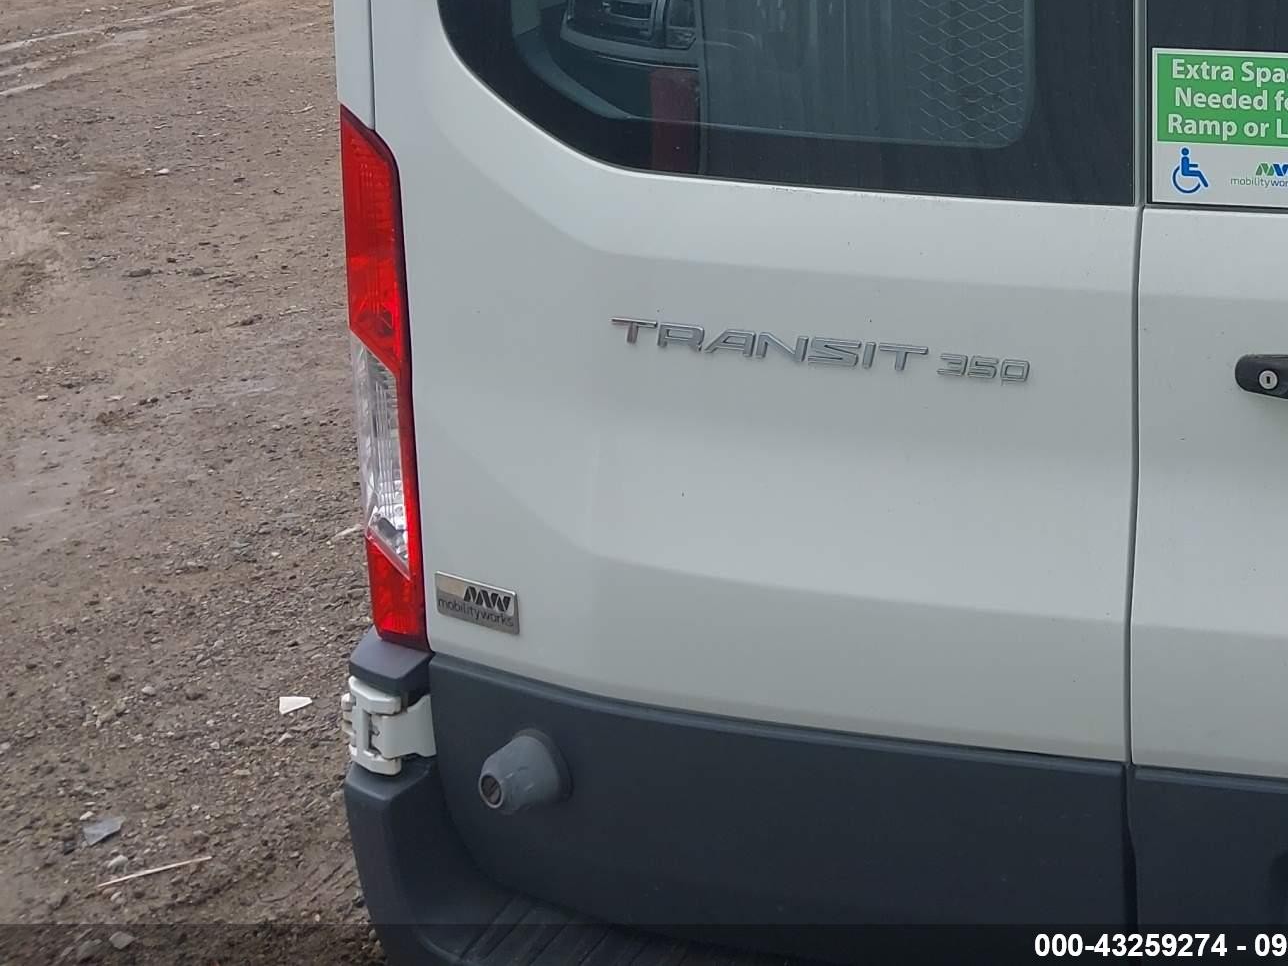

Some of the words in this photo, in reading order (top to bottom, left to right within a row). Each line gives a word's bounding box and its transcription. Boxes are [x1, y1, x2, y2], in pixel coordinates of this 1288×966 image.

[1171, 58, 1234, 81] Extra
[1174, 87, 1268, 111] Needed
[1168, 114, 1237, 140] Ramp
[1243, 122, 1270, 138] or
[610, 317, 929, 372] TRANSIT
[936, 353, 1030, 384] 350
